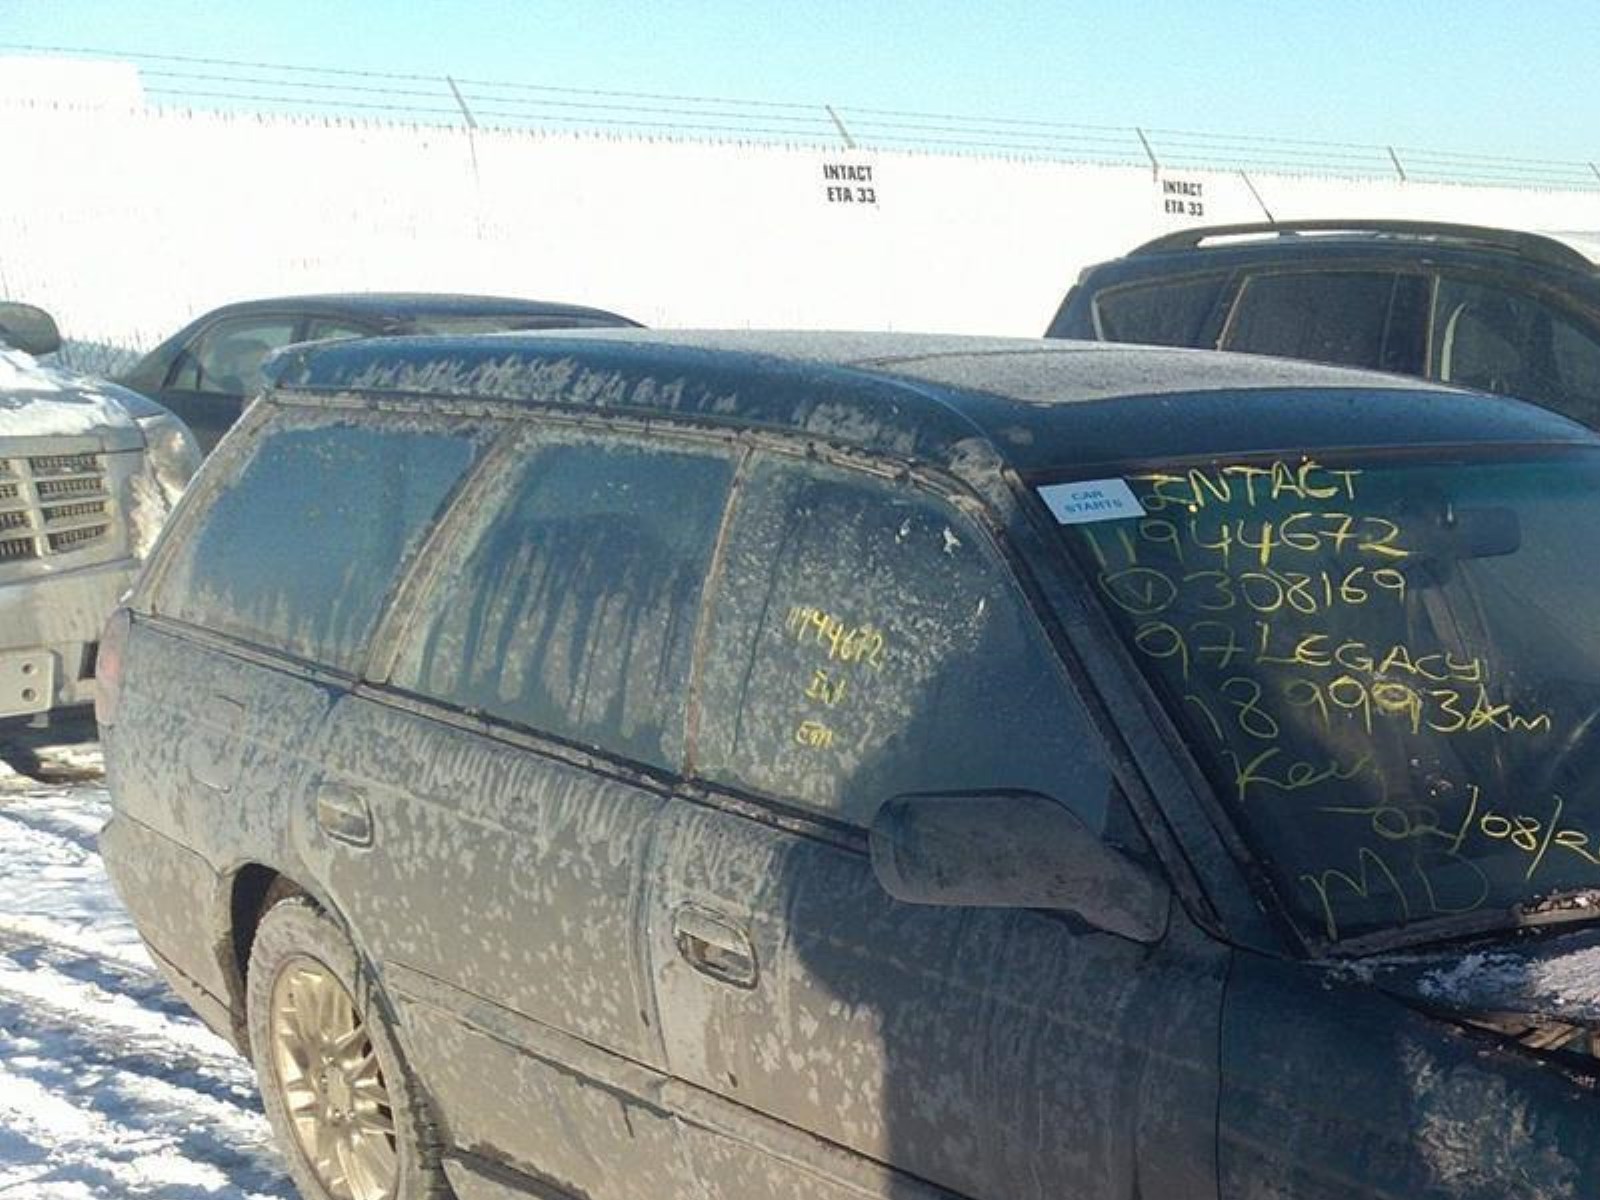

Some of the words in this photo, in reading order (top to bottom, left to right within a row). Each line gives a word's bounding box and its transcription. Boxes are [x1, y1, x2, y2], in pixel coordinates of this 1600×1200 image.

[823, 163, 872, 181] INTACT
[827, 186, 854, 202] ETA
[857, 187, 876, 203] 33
[1163, 180, 1202, 197] INTACT
[1165, 199, 1185, 214] ETA
[1187, 202, 1204, 216] 33
[1123, 460, 1362, 510] INTACT
[1085, 512, 1408, 570] 11944672
[1183, 566, 1406, 614] 308169
